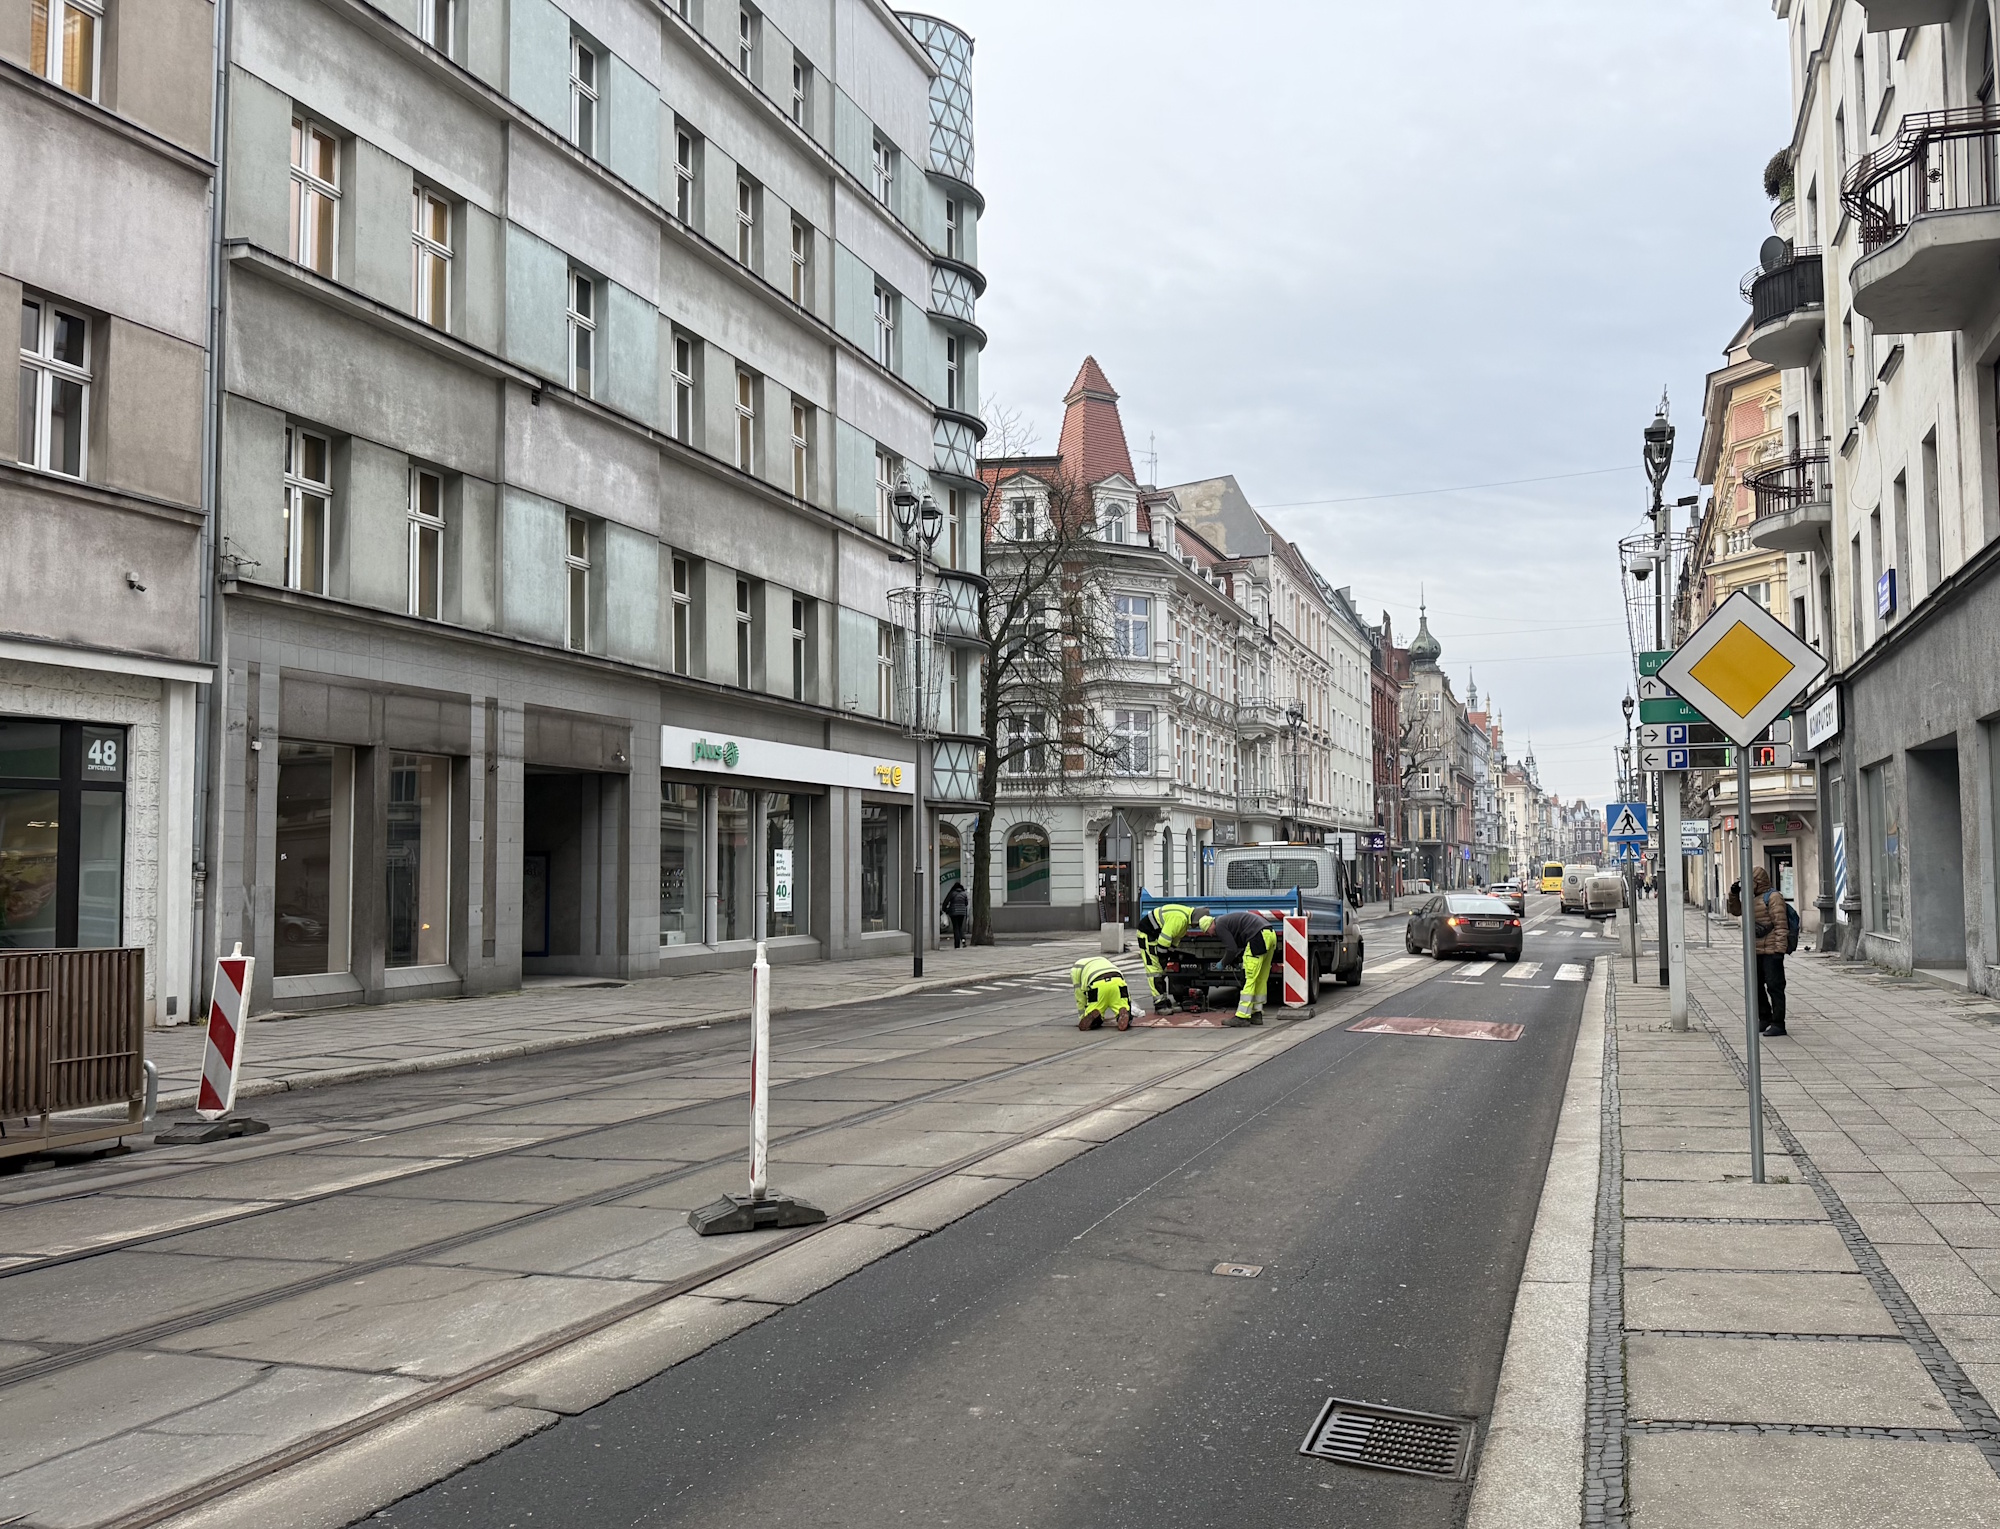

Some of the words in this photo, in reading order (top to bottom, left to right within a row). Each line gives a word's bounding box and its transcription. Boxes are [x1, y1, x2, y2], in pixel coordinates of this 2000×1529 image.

[1646, 660, 1658, 668] ul.
[1809, 700, 1834, 738] KOMPUTERY
[88, 739, 117, 766] 48
[692, 738, 722, 762] plus
[775, 884, 787, 898] 40
